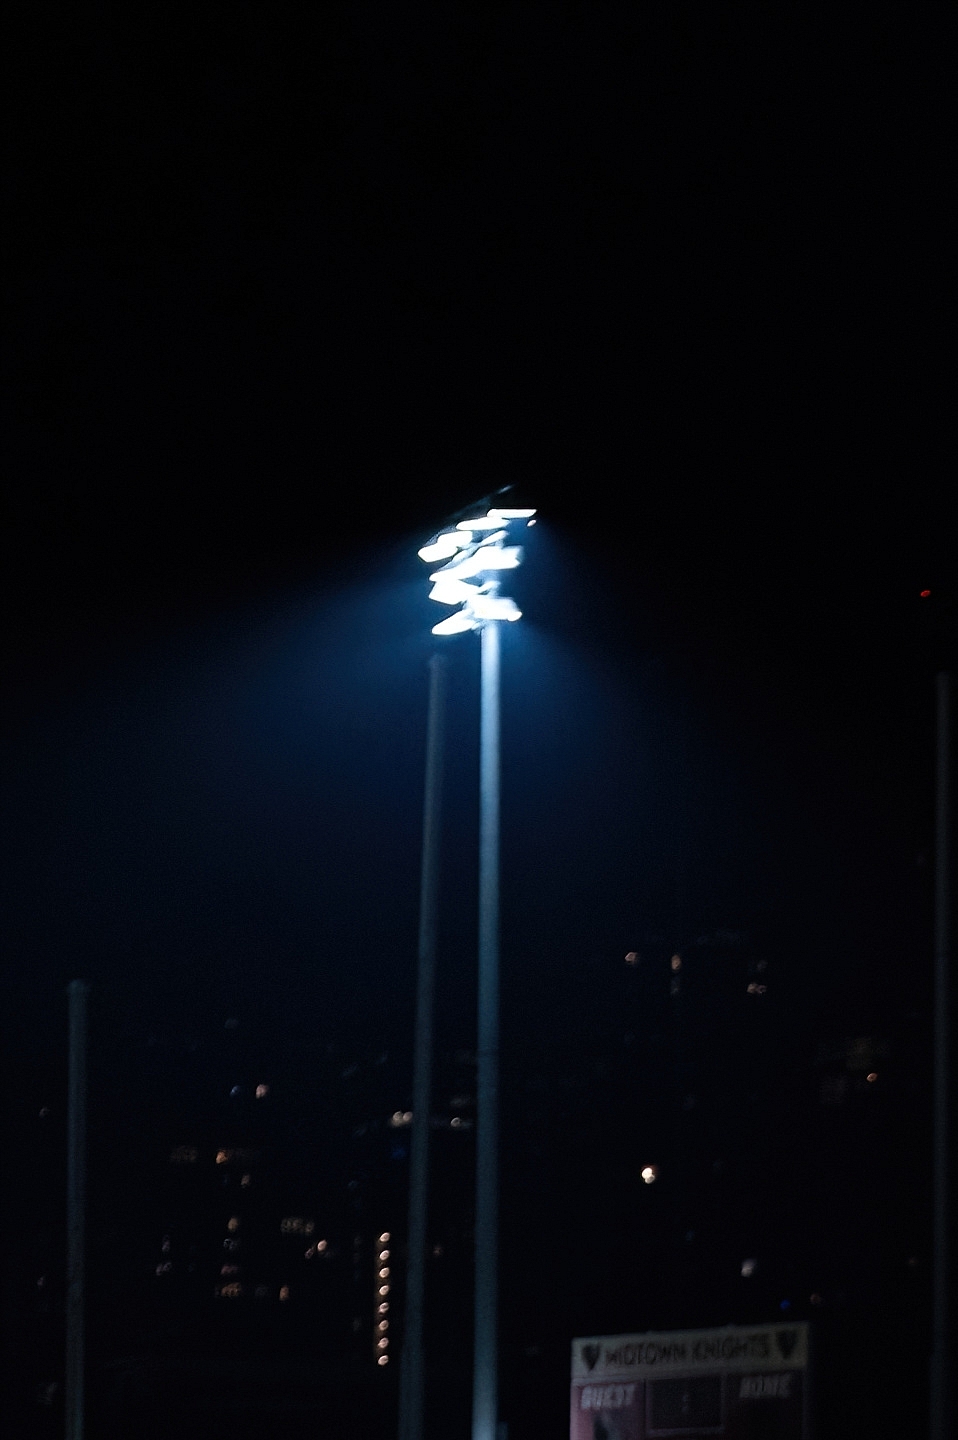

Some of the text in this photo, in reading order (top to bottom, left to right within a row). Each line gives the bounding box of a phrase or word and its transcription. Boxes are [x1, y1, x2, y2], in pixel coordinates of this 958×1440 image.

[605, 1333, 770, 1366] MIDTOWN KNIGHTS
[580, 1383, 636, 1410] GUEST
